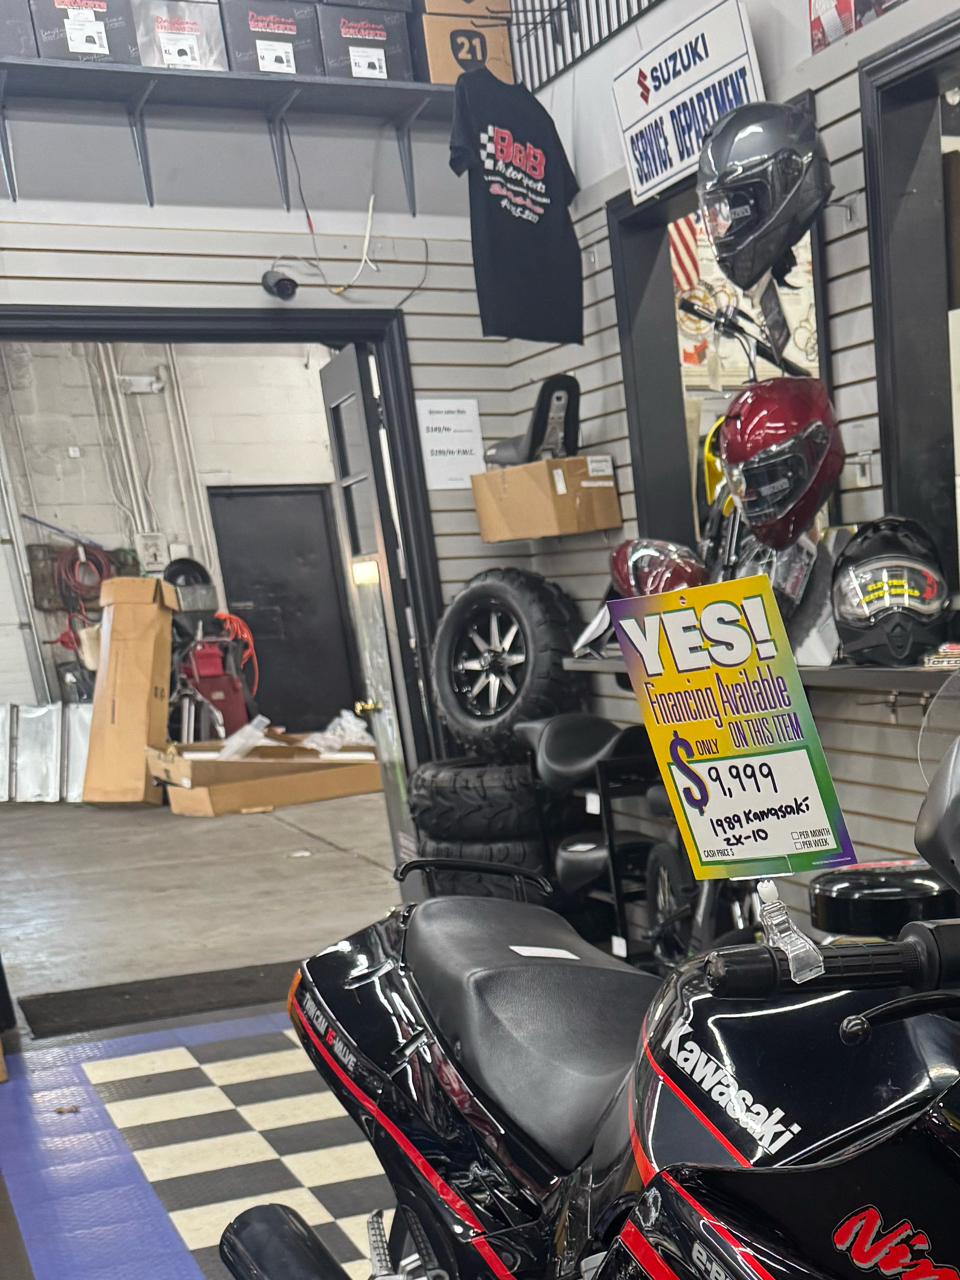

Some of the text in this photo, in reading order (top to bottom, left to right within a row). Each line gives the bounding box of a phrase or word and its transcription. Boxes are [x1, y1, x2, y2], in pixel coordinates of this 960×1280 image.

[457, 36, 483, 60] 21
[651, 33, 709, 92] SUZUKI
[630, 116, 674, 186] SERVICE
[619, 594, 778, 678] YES!
[644, 664, 792, 729] Financing Available
[695, 738, 720, 756] ONLY
[728, 712, 804, 749] ON THIS ITEM
[669, 730, 778, 816] $ 9,999
[709, 796, 810, 837] 1989 Kawasaki
[799, 828, 831, 840] PER MONTH
[704, 850, 717, 858] CASH
[717, 849, 731, 857] PRICE
[802, 838, 830, 849] PER WEEK
[661, 1021, 802, 1156] Kawasaki
